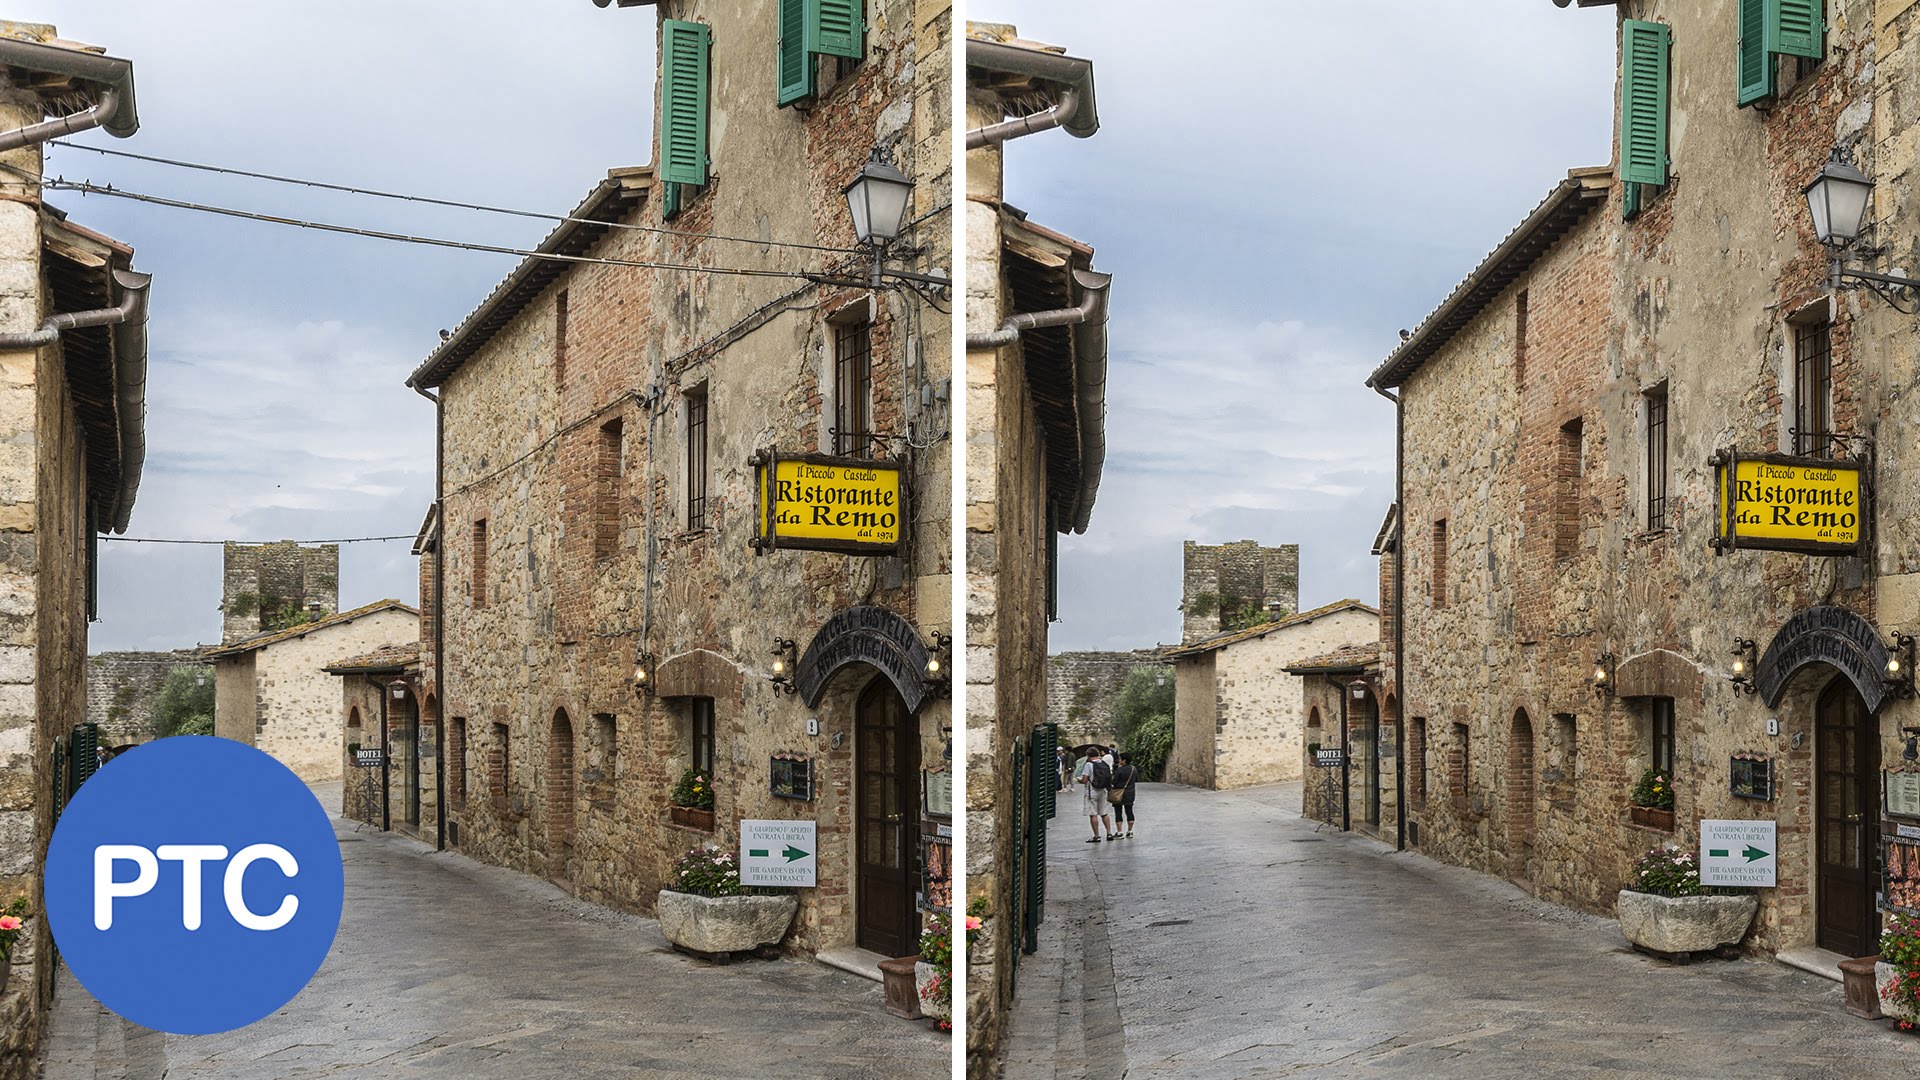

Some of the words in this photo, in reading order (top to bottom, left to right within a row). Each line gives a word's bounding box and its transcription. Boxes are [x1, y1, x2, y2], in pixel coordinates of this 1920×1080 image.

[797, 465, 804, 478] Il
[806, 466, 835, 480] Piccolo
[843, 469, 877, 482] Castello
[1757, 465, 1764, 478] Il
[1766, 466, 1795, 480] Piccolo
[1803, 469, 1837, 482] Castello
[776, 480, 894, 507] Ristorante
[1736, 480, 1854, 507] Ristorante
[776, 510, 801, 525] da
[809, 505, 896, 528] Remo
[1736, 510, 1761, 525] da
[1769, 505, 1856, 528] Remo
[857, 529, 872, 538] dal
[876, 531, 893, 540] 1974
[1817, 529, 1832, 538] dal
[1836, 531, 1853, 540] 1974
[860, 607, 914, 651] CASTELLO
[1820, 607, 1874, 651] CASTELLO
[356, 750, 383, 759] HOTEL
[1316, 750, 1343, 759] HOTEL
